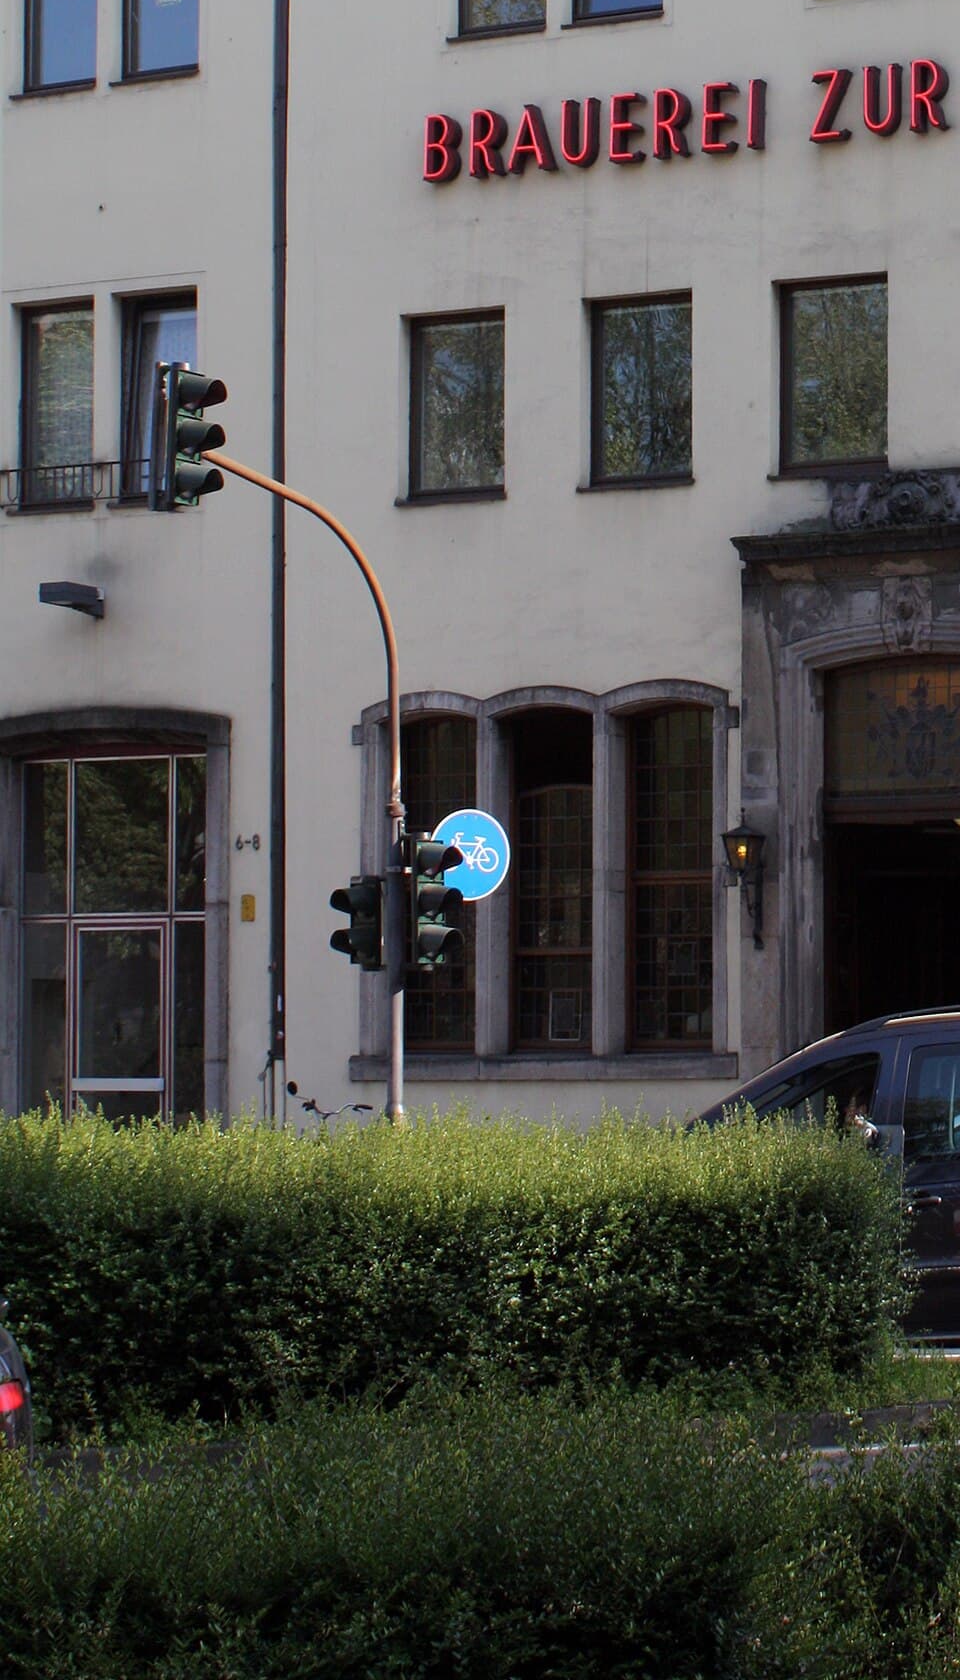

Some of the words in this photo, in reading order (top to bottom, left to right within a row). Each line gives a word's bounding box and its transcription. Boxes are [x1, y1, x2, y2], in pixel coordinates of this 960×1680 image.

[423, 78, 768, 183] BRAUEREI
[809, 59, 951, 144] ZUR
[235, 834, 261, 851] 6-8
